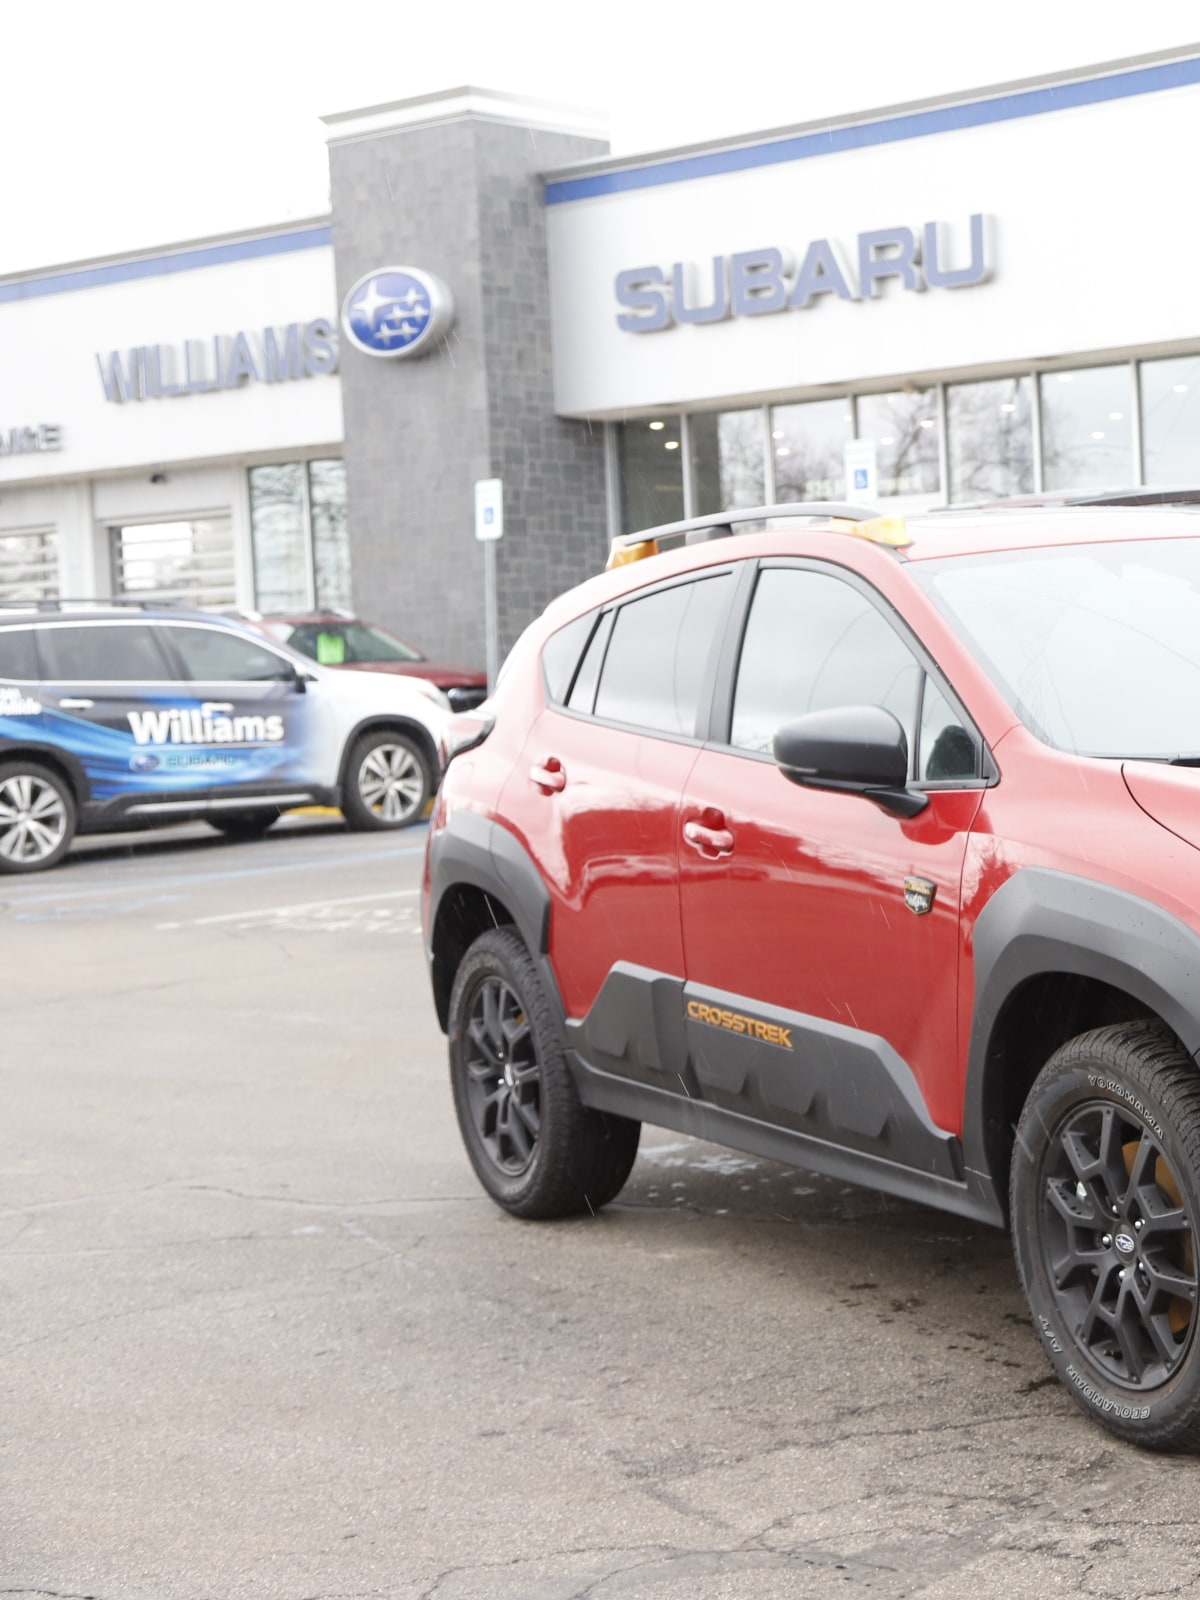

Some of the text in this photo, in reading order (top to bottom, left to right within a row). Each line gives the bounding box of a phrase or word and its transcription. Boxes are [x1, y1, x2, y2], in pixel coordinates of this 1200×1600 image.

[615, 213, 990, 335] SUBARU
[95, 317, 341, 403] WILLIAMS
[127, 708, 285, 745] Williams
[687, 1001, 793, 1048] CROSSTREK
[1087, 1073, 1164, 1140] YOKOHAMA
[1066, 1364, 1151, 1419] GEOLANDAR
